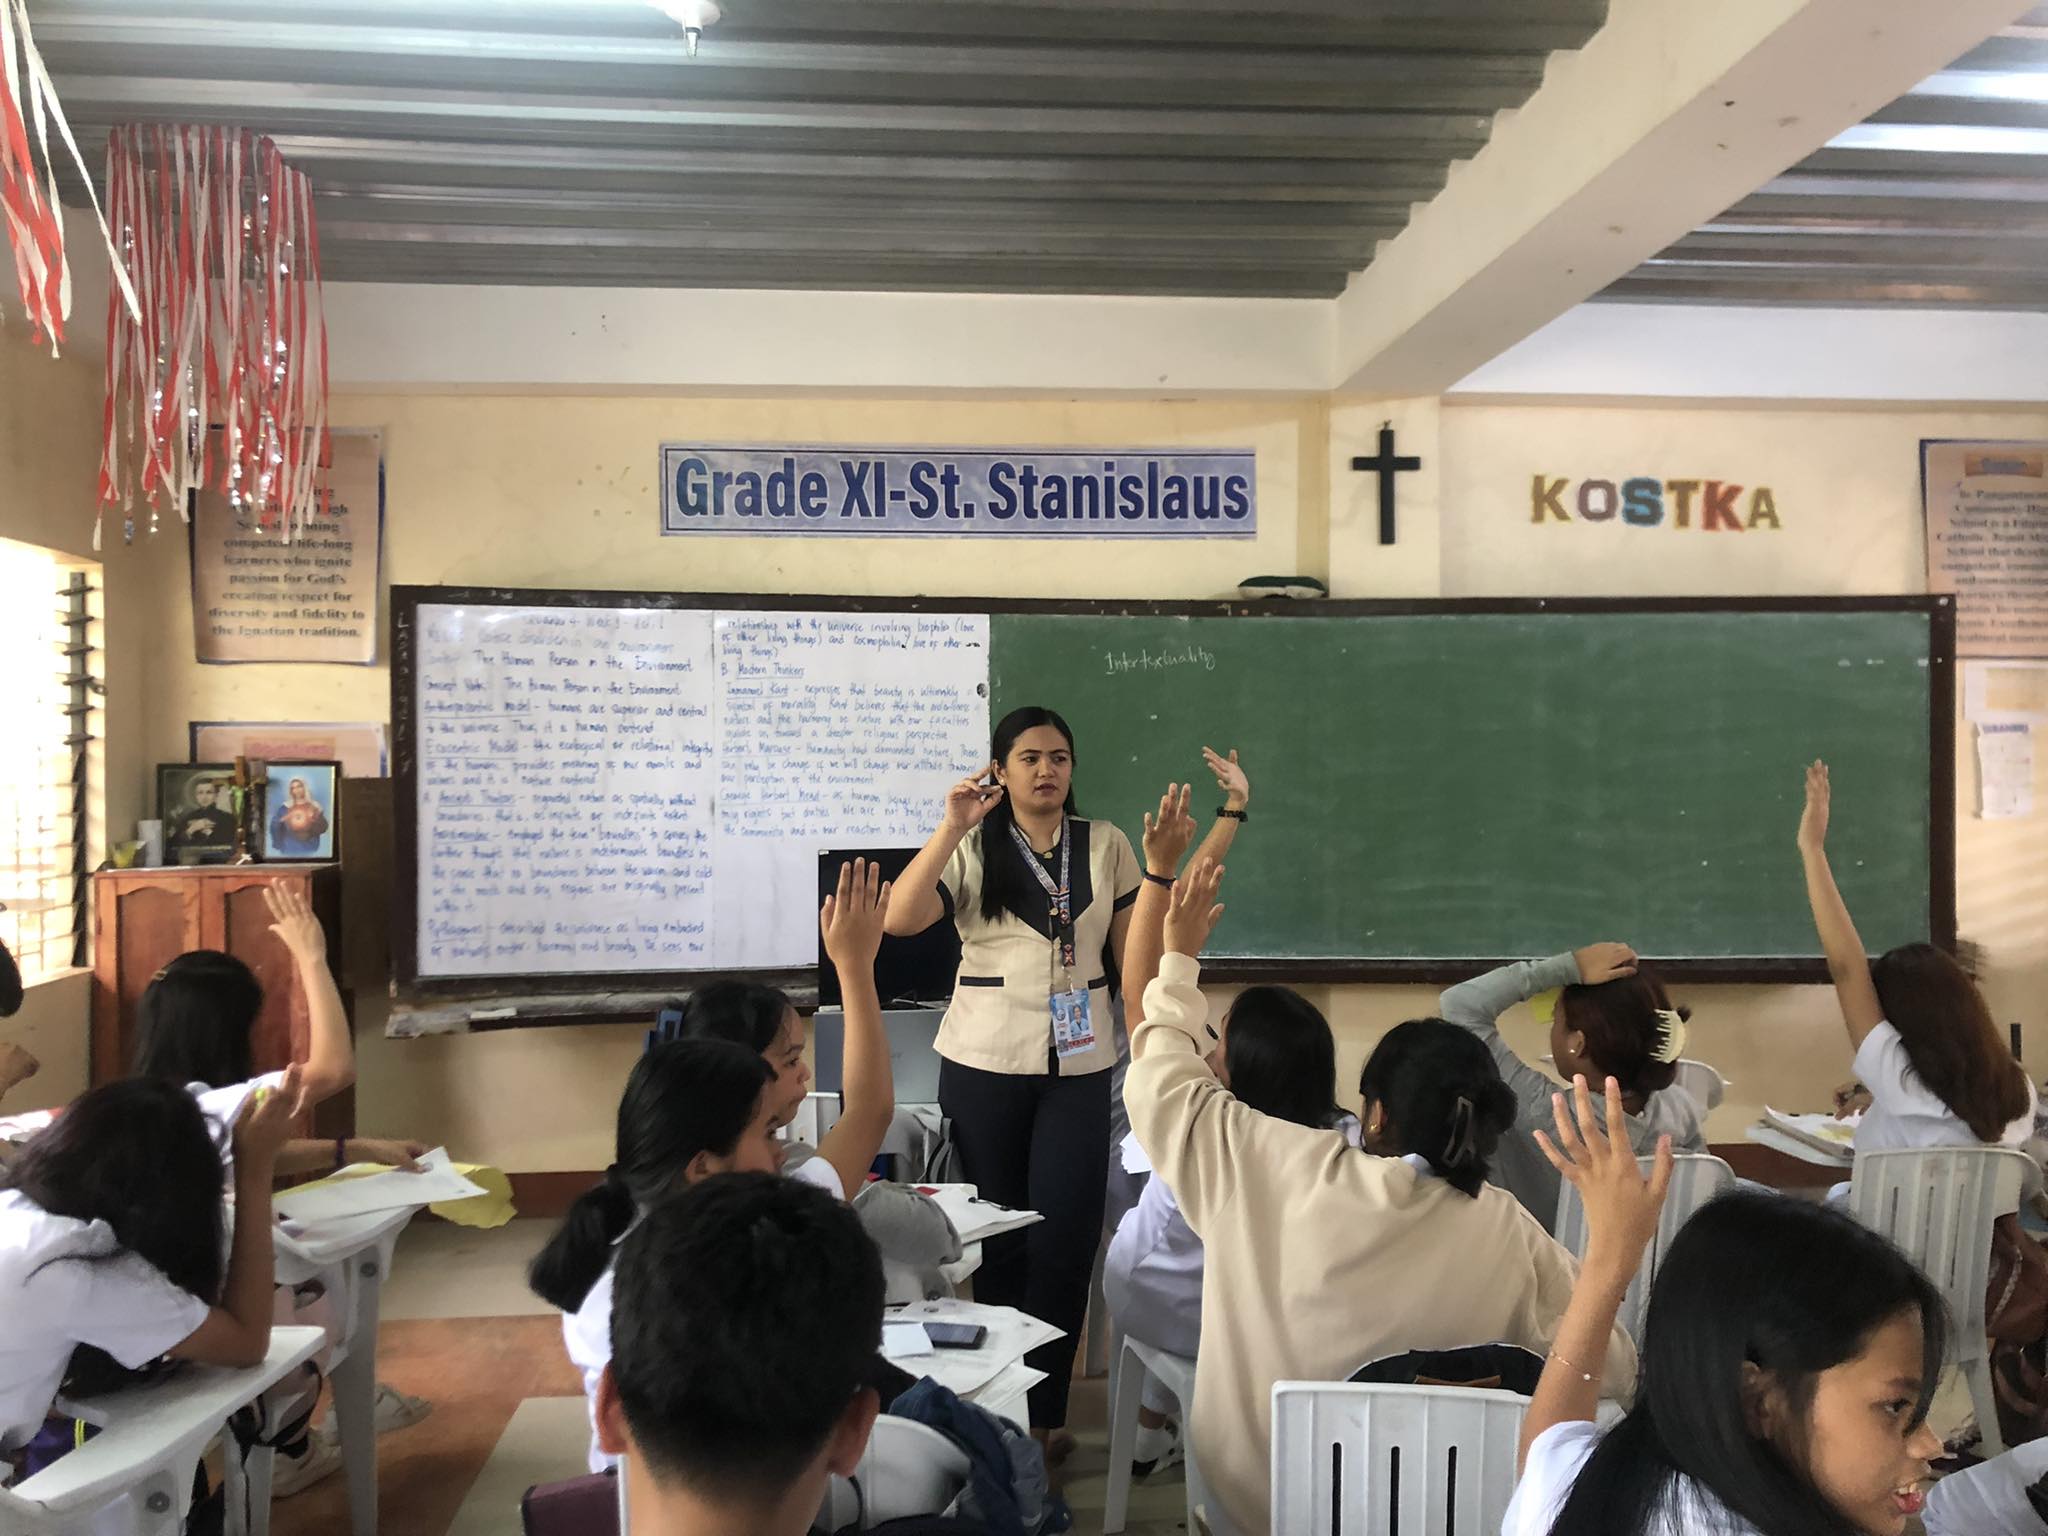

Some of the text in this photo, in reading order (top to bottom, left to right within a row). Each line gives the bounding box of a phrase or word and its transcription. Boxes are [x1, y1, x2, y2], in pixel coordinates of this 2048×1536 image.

[676, 457, 1249, 520] Grade XI-St. Stanislaus
[1531, 475, 1780, 531] KOSTKA
[297, 538, 353, 552] life-long
[224, 556, 352, 569] learners who ignite
[229, 572, 279, 584] passion
[284, 572, 303, 583] for
[222, 590, 353, 603] creation respect for
[208, 607, 365, 620] diversity and fidelity to
[212, 625, 233, 636] the
[239, 626, 295, 638] Ignatian
[870, 620, 911, 638] involving
[955, 616, 976, 632] (love
[828, 635, 845, 645] and
[606, 655, 623, 670] the
[1104, 645, 1216, 675] Intertextuality
[737, 662, 805, 677] Modern Thinkers
[727, 682, 764, 695] Immanuel
[769, 681, 789, 696] Kant
[849, 682, 866, 696] that
[873, 683, 903, 699] beauty
[655, 703, 673, 717] and
[854, 698, 886, 711] believes
[892, 700, 909, 713] that
[912, 699, 925, 711] the
[929, 714, 970, 729] faculties
[863, 725, 899, 742] religious
[758, 741, 791, 753] Marcuse
[829, 761, 839, 769] we
[843, 757, 858, 769] will
[743, 774, 785, 788] perception
[808, 773, 821, 784] the
[798, 788, 821, 801] Mead
[851, 788, 881, 803] human
[842, 803, 855, 815] We
[860, 806, 876, 817] are
[884, 806, 898, 817] not
[790, 824, 806, 836] and
[846, 824, 882, 835] reaction
